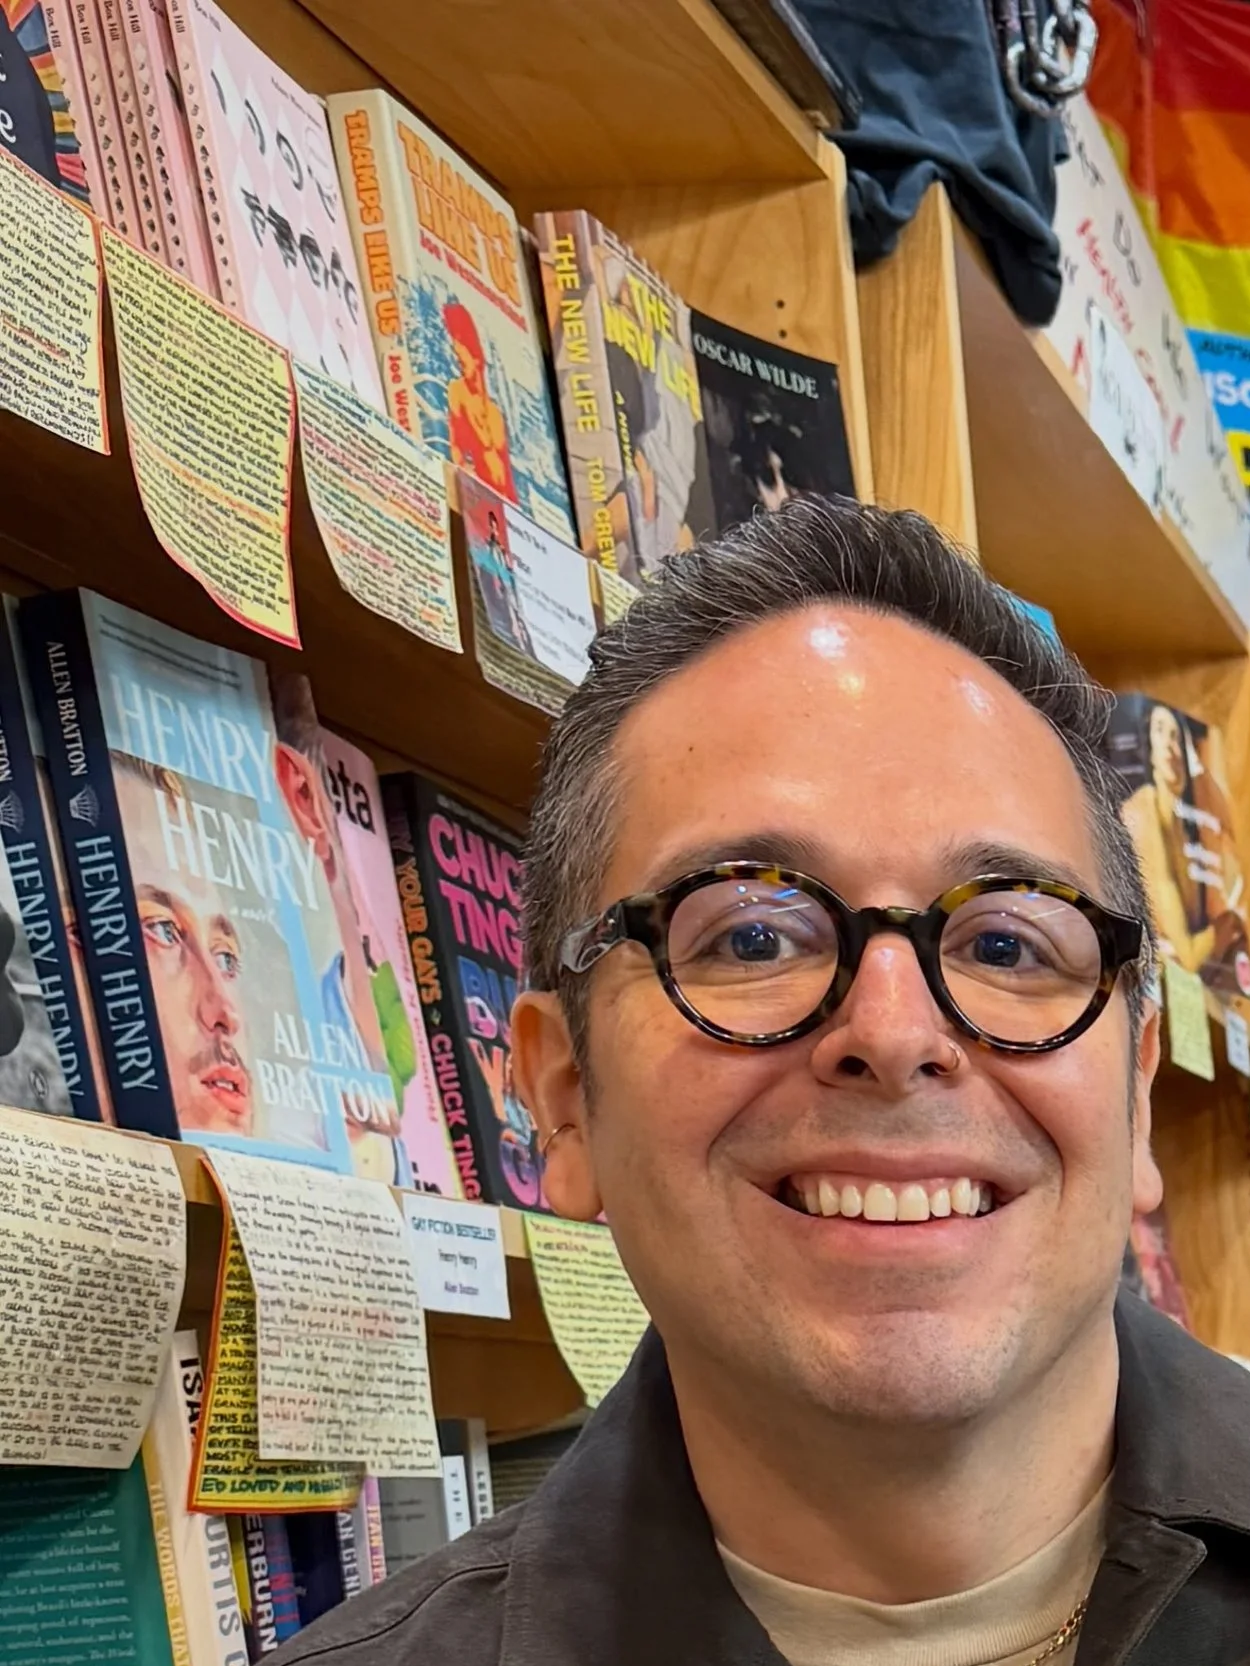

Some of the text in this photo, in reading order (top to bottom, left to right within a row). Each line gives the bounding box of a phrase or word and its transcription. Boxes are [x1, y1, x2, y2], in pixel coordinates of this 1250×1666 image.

[345, 110, 384, 226] TRAMPS
[398, 120, 515, 240] TRAMPS
[364, 230, 395, 294] LIKE
[411, 175, 523, 308] LIKE US
[376, 298, 398, 337] US
[603, 302, 656, 373] NEW
[627, 272, 673, 340] THE
[388, 355, 401, 384] Joe
[693, 333, 752, 376] OSCAR
[552, 234, 619, 574] THE NEW LIFE TOM CREW
[110, 674, 272, 803] HENRY
[46, 641, 159, 1091] ALLEN BRATTON HENRY HENRY
[154, 786, 320, 911] HENRY
[428, 813, 523, 909] CHUC
[6, 841, 58, 964] HENRY
[396, 856, 428, 933] YOUR
[438, 879, 523, 969] TING
[411, 938, 442, 1004] GAYS
[274, 1011, 370, 1072] ALLEN
[431, 1033, 467, 1126] CHUCK
[256, 1058, 391, 1126] BRATTON
[452, 1134, 482, 1200] TING
[411, 1216, 497, 1241] GAY FICTION BESTSELLER
[149, 1481, 164, 1523] THE
[157, 1527, 184, 1608] WORDS
[205, 1517, 240, 1637] URTIS
[246, 1515, 279, 1652] ERBURN
[343, 1547, 364, 1600] GENE
